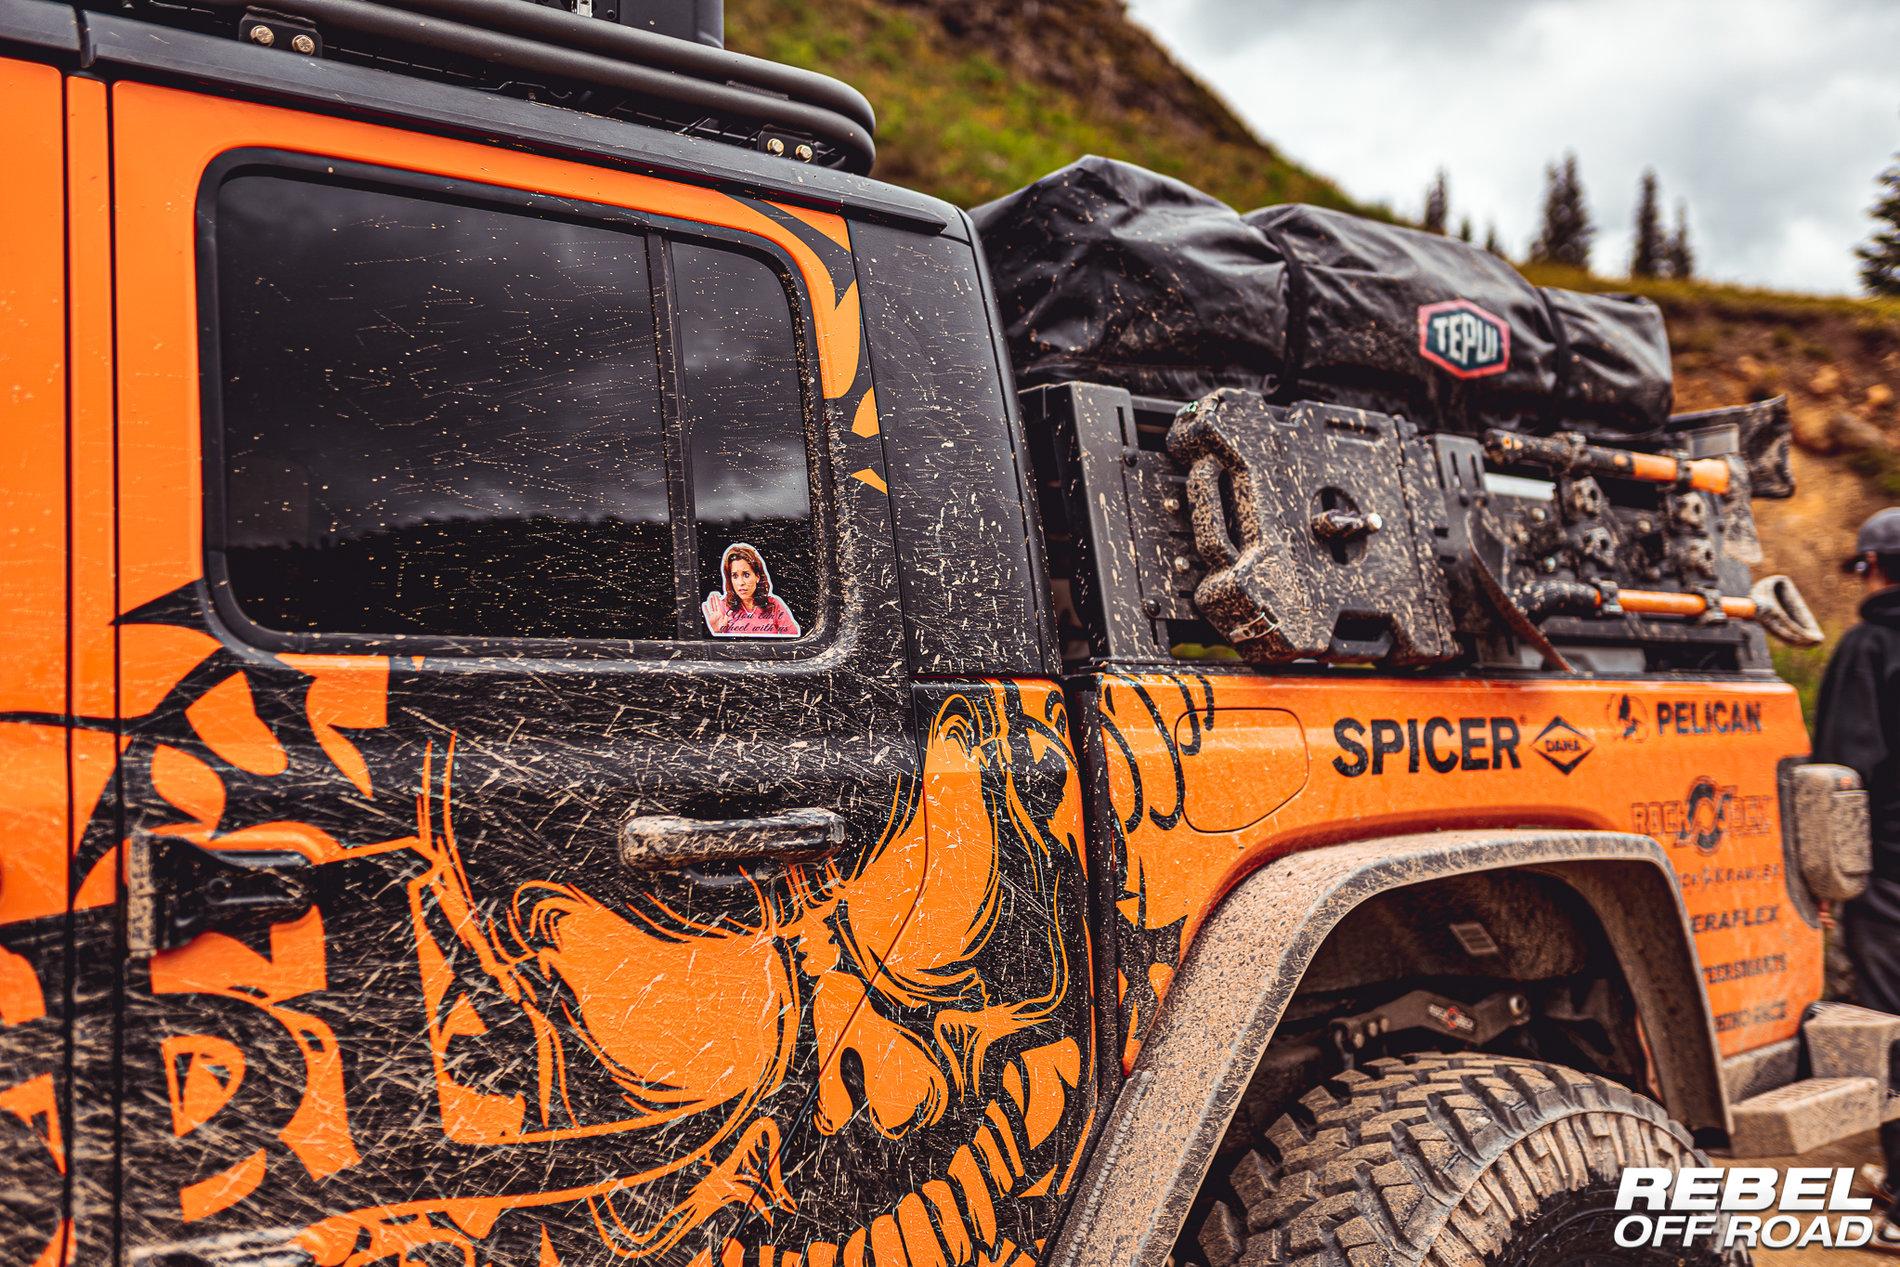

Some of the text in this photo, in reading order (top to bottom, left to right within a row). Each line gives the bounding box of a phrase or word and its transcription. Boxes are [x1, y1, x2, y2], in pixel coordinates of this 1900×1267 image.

[1432, 313, 1498, 365] TEPUI
[751, 622, 774, 632] with
[1656, 701, 1762, 735] PELICAN
[1331, 716, 1521, 777] SPICER
[1690, 904, 1780, 934] ERAFLEX
